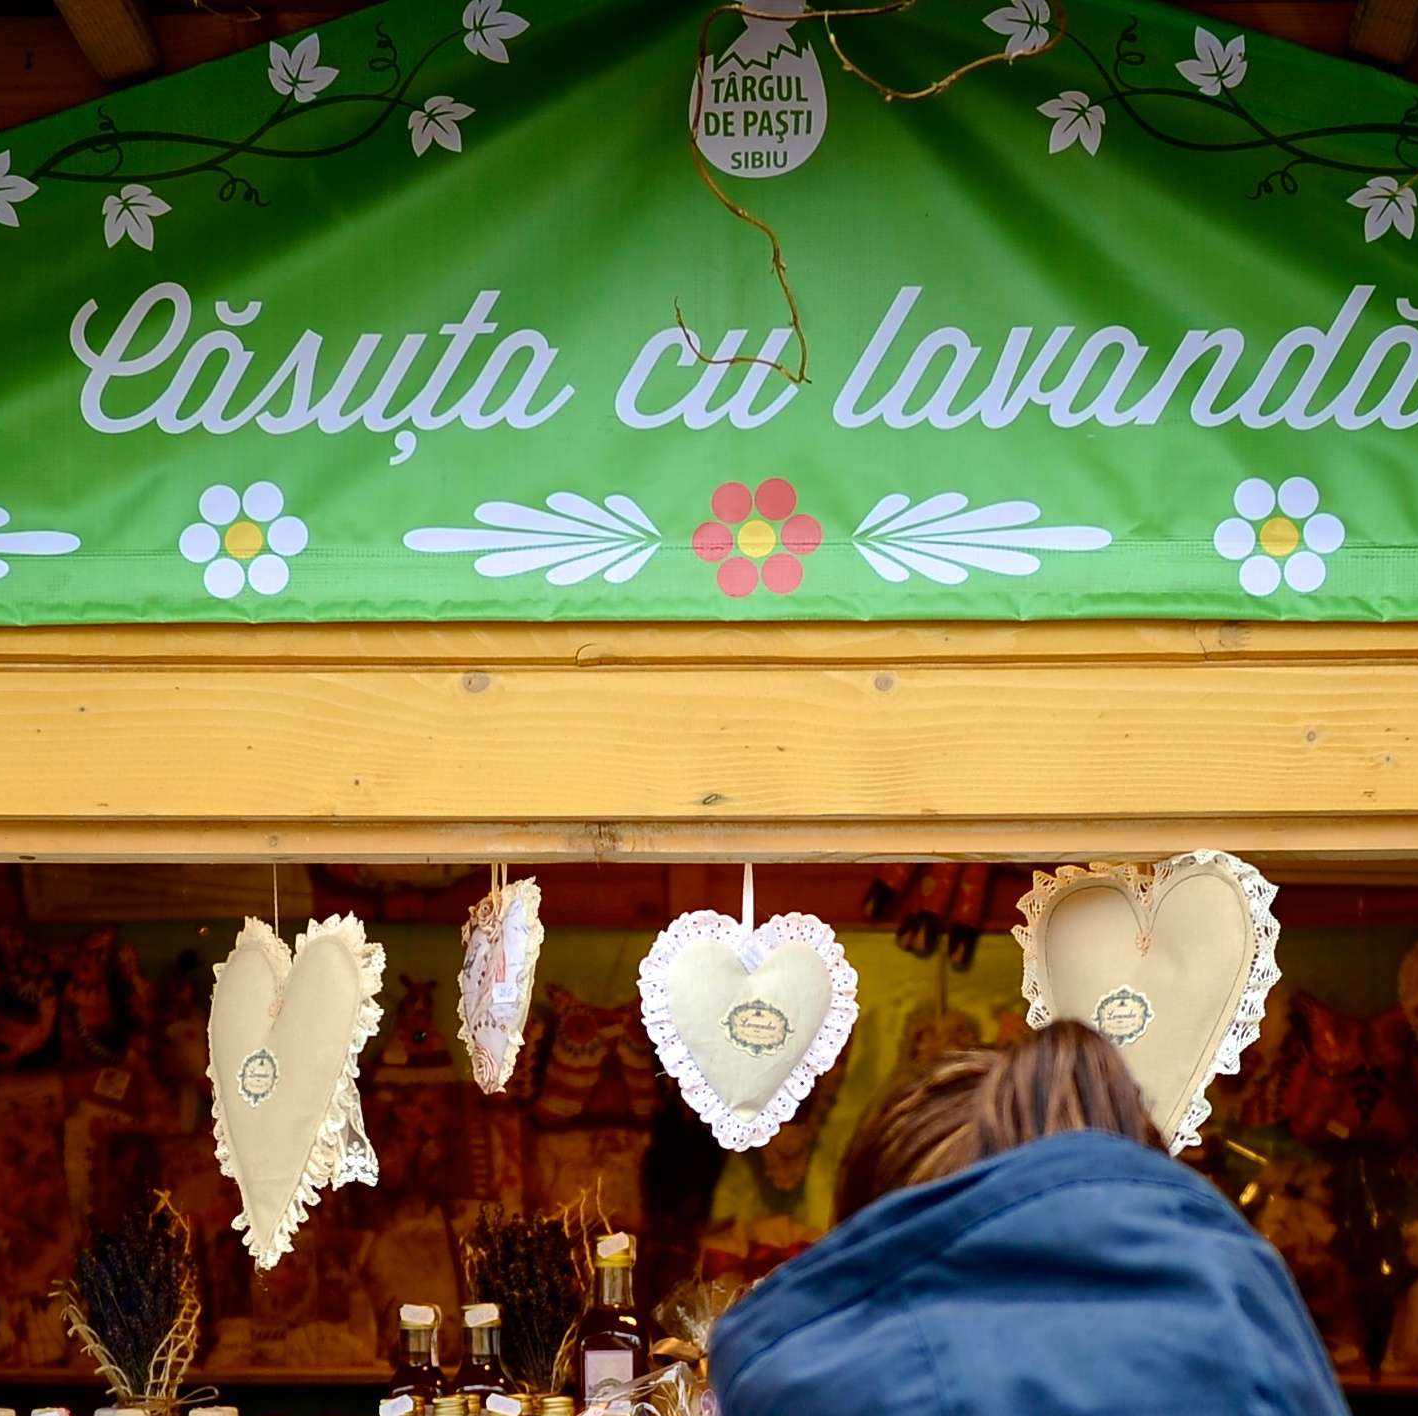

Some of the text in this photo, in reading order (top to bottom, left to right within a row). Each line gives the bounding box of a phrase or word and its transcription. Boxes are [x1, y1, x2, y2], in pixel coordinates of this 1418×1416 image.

[711, 72, 808, 104] TÂRGUL
[704, 111, 735, 137] DE
[731, 151, 788, 169] SIBIU
[615, 325, 805, 430] cu
